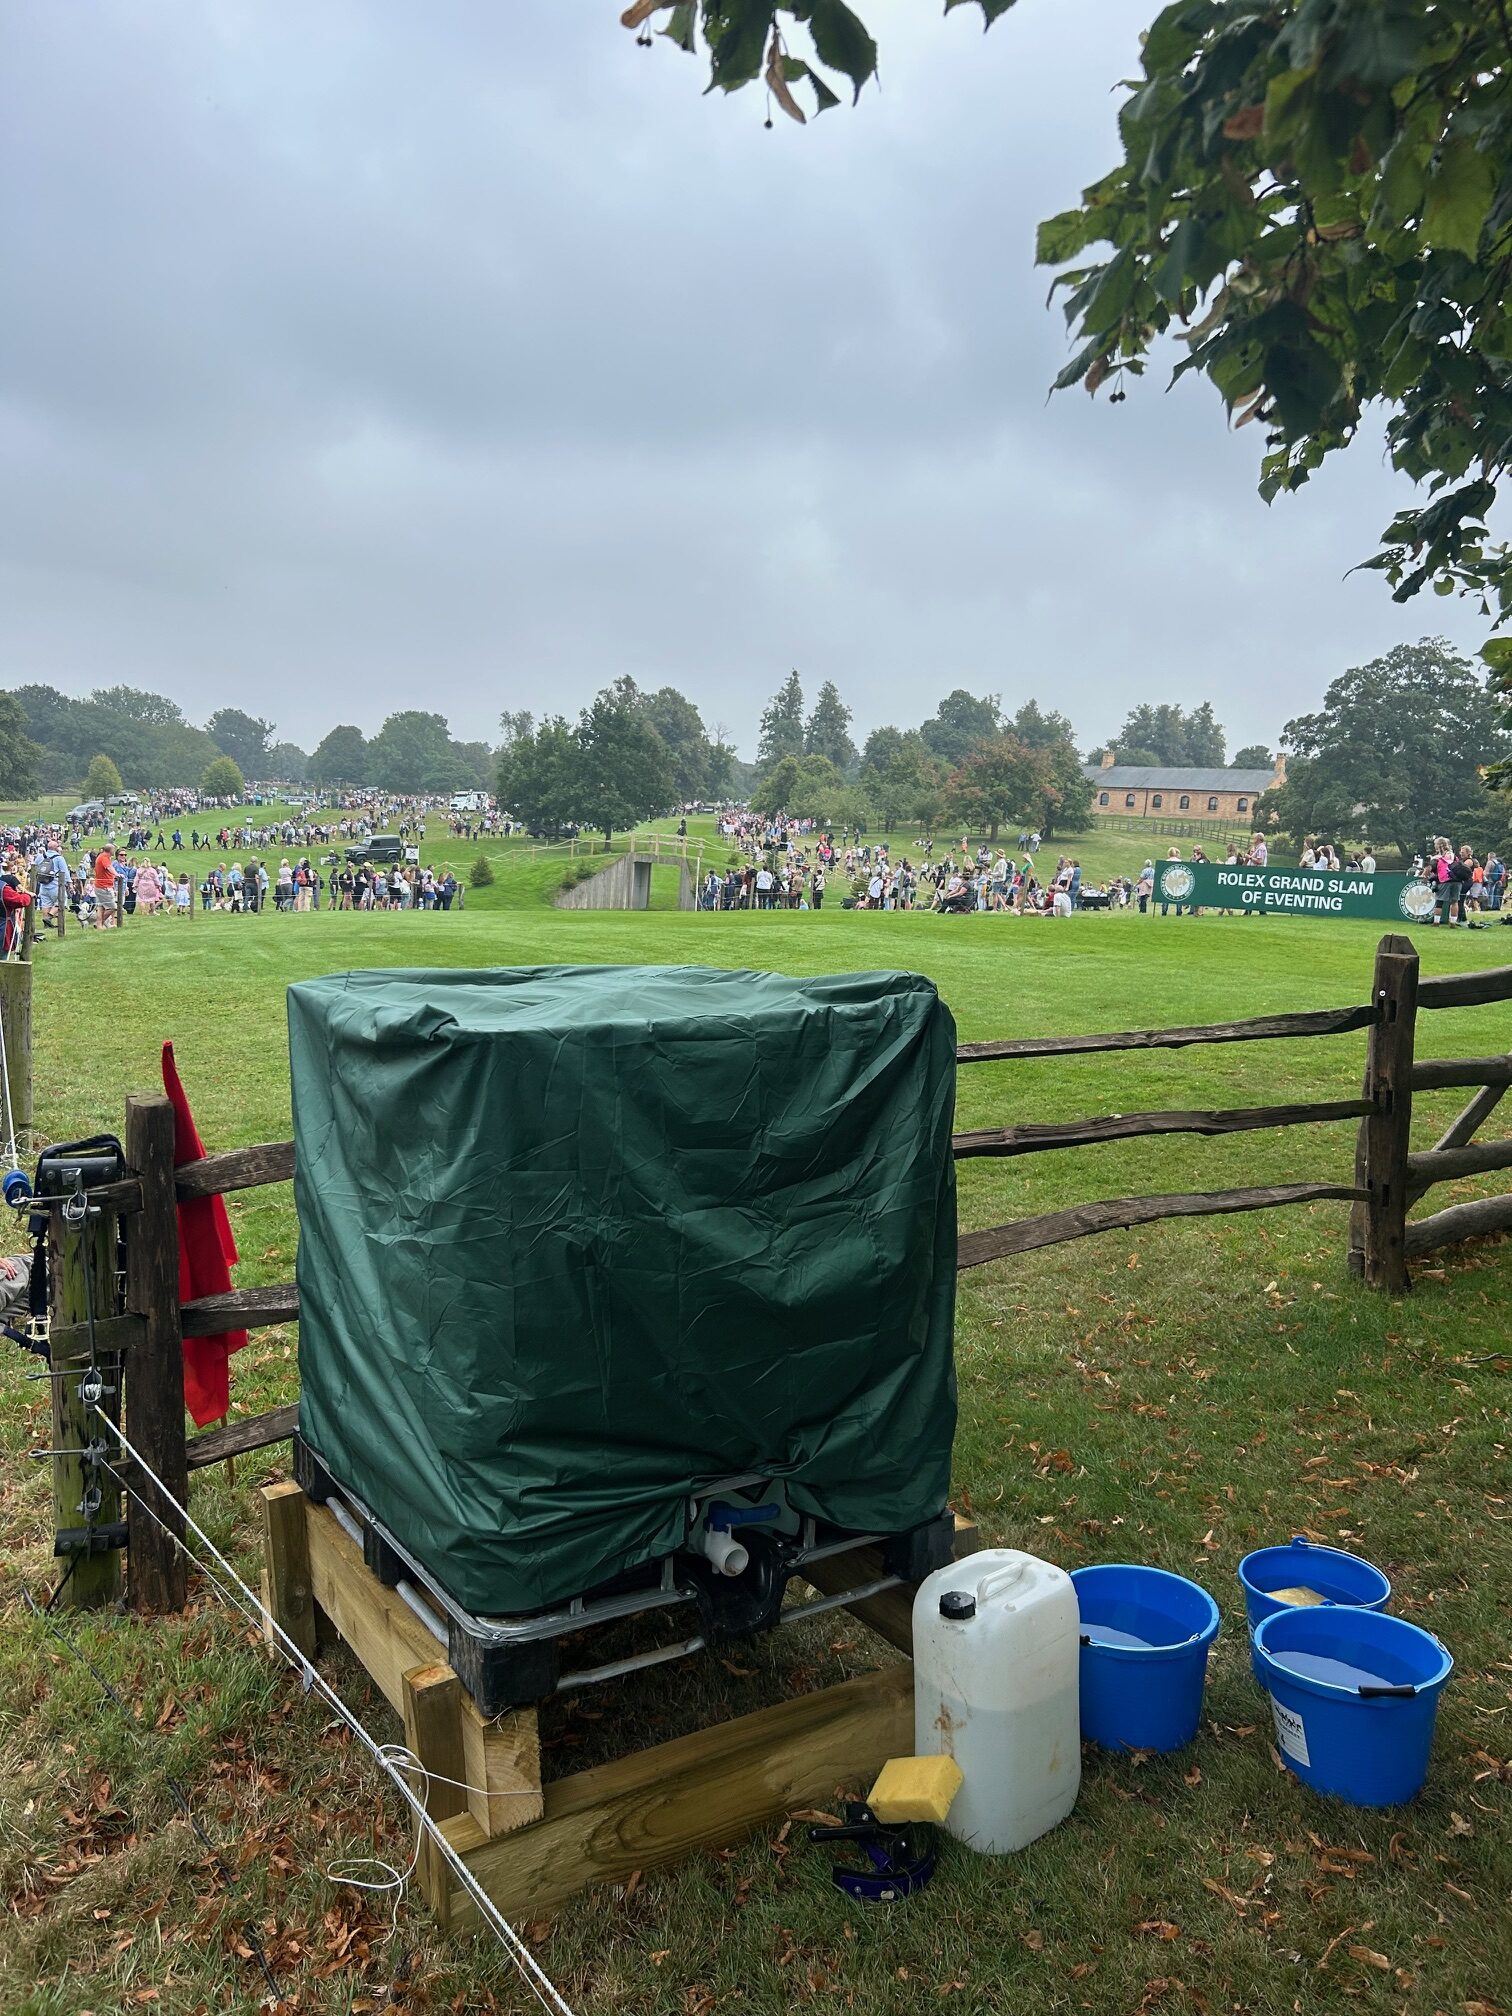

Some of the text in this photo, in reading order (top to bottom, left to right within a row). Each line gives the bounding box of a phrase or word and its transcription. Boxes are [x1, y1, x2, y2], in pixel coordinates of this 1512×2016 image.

[1217, 872, 1374, 896] ROLEX GRAND SLAM
[1241, 890, 1343, 911] OF EVENTING
